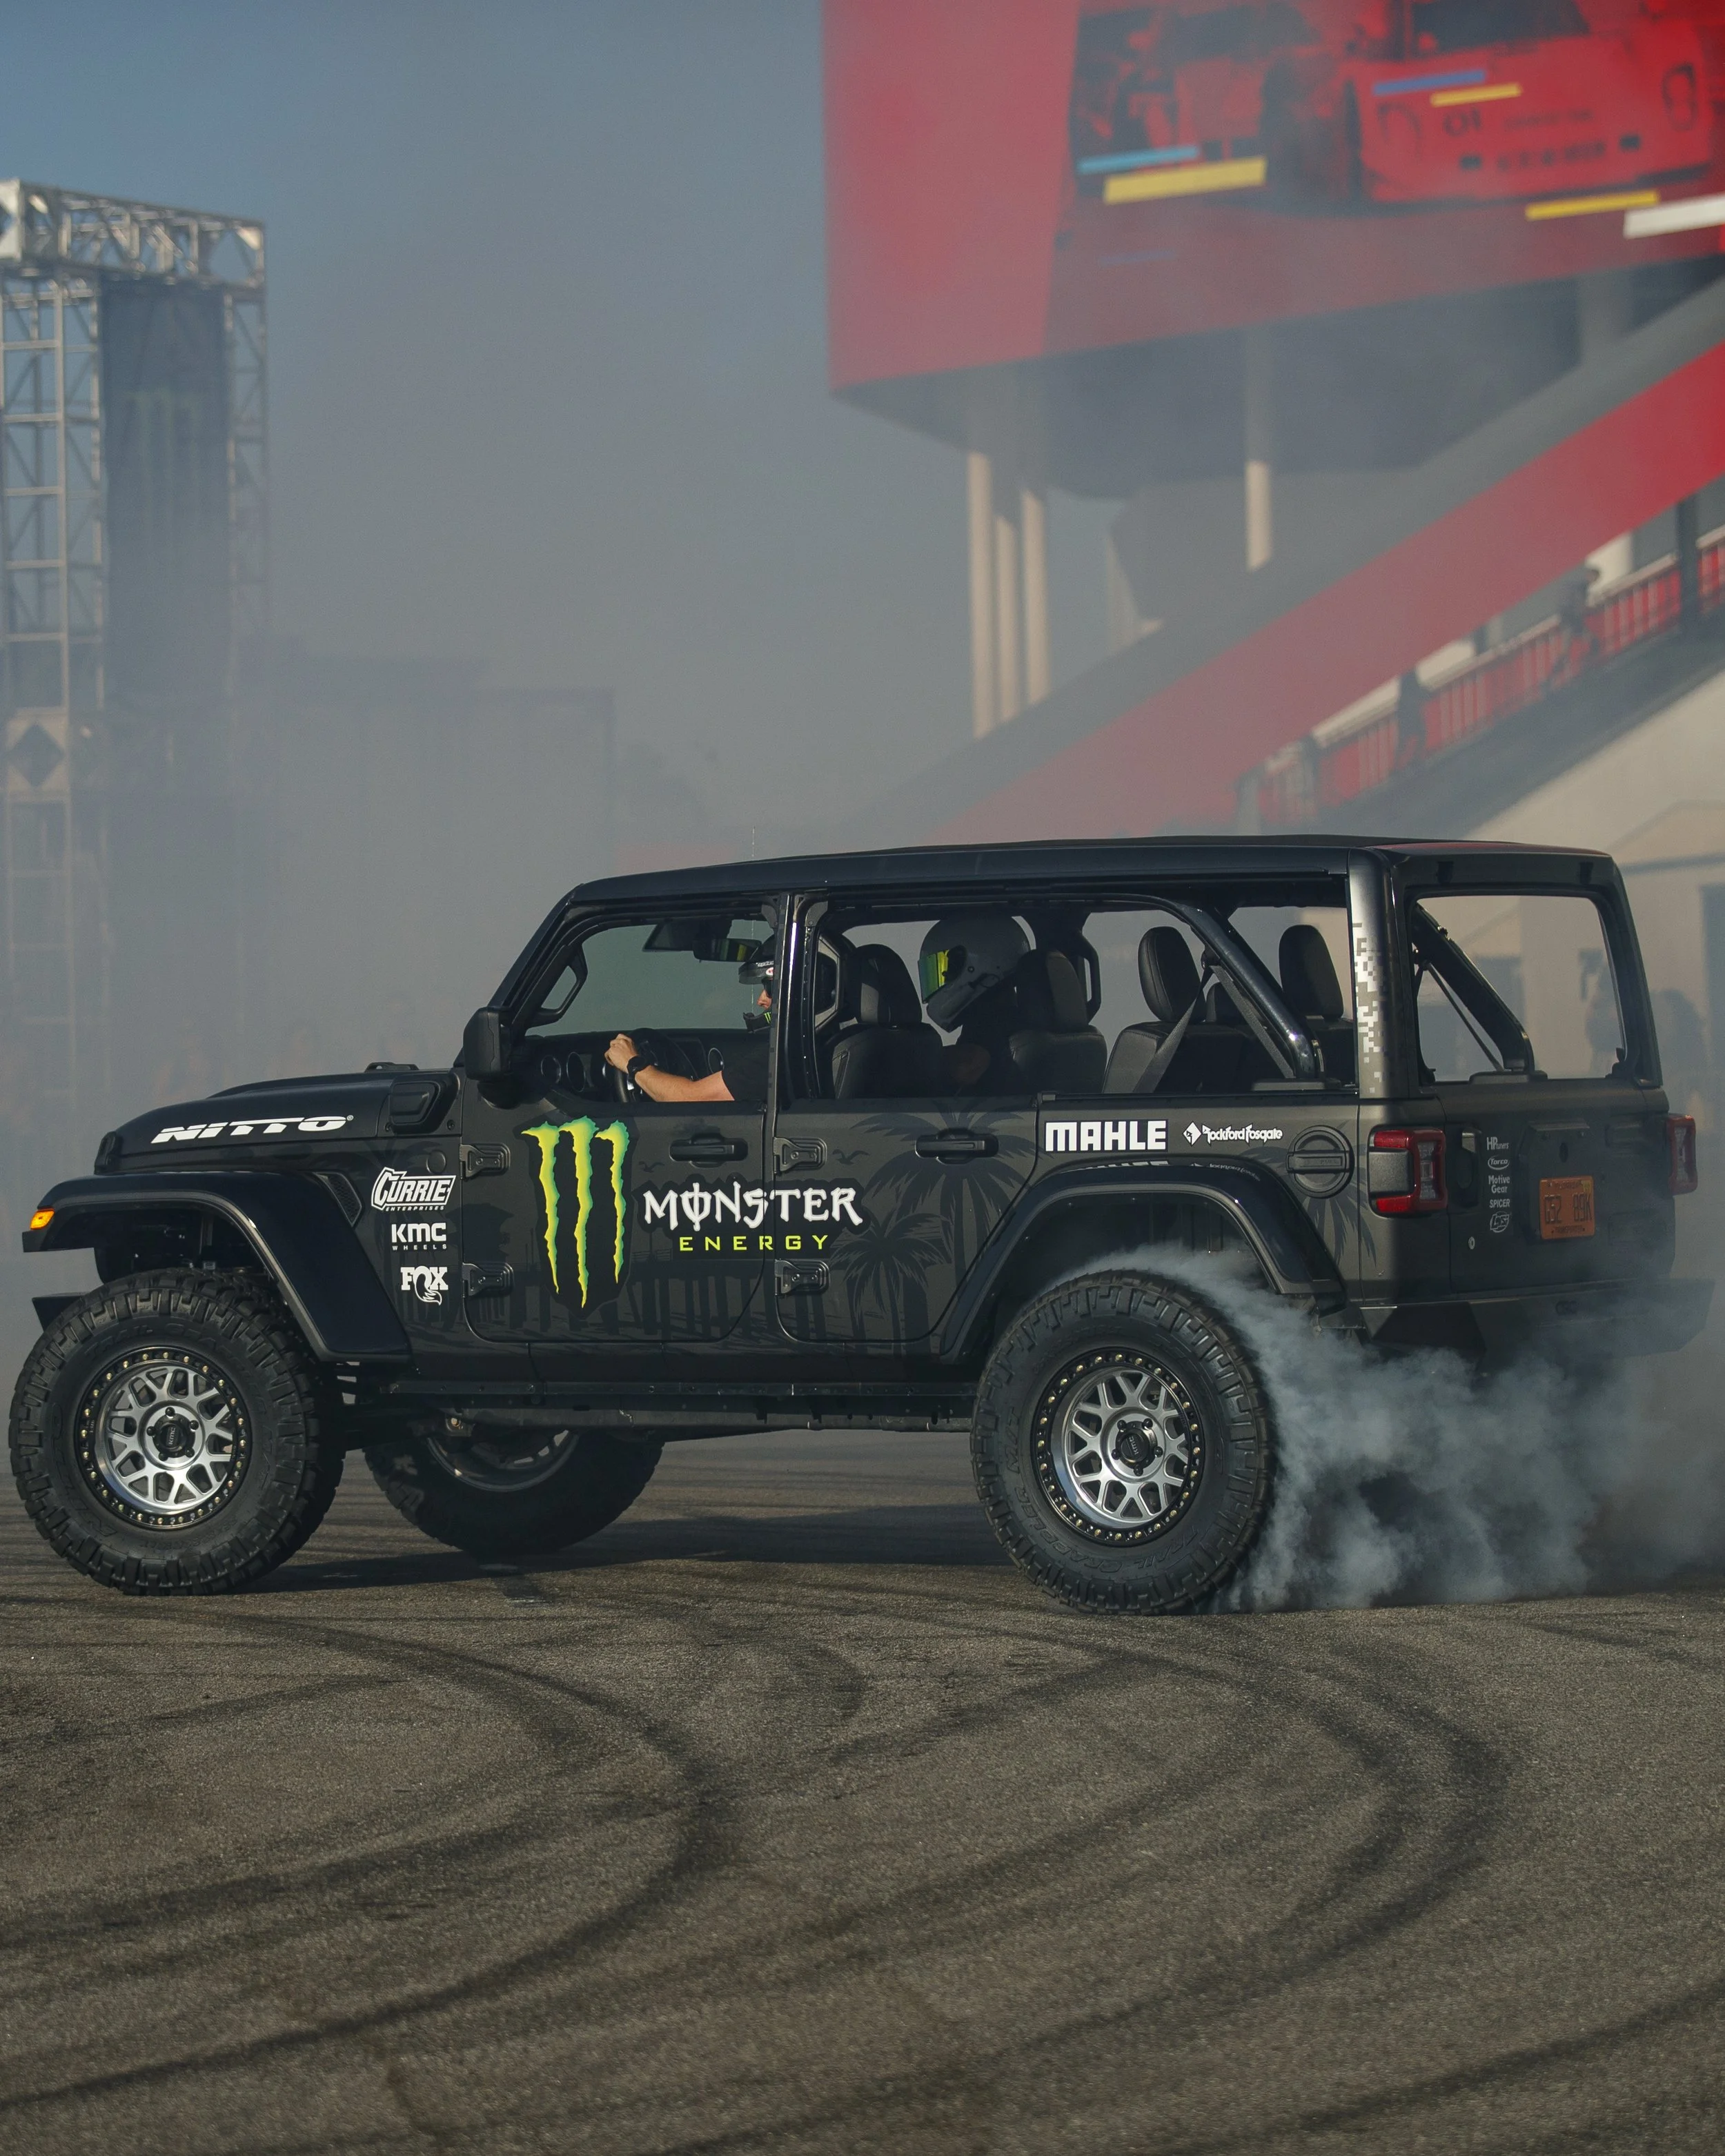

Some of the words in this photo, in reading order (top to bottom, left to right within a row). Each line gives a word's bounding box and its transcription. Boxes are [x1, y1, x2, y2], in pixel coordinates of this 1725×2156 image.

[151, 1116, 346, 1143] NITTO
[1045, 1120, 1166, 1151] MAHLE
[374, 1171, 451, 1206] CURRIE
[1488, 1174, 1510, 1185] Motive
[1491, 1184, 1508, 1194] Gear
[643, 1181, 862, 1232] MONSTER
[1489, 1198, 1510, 1208] SPICER
[679, 1235, 828, 1252] ENERGY
[400, 1265, 448, 1305] FOX
